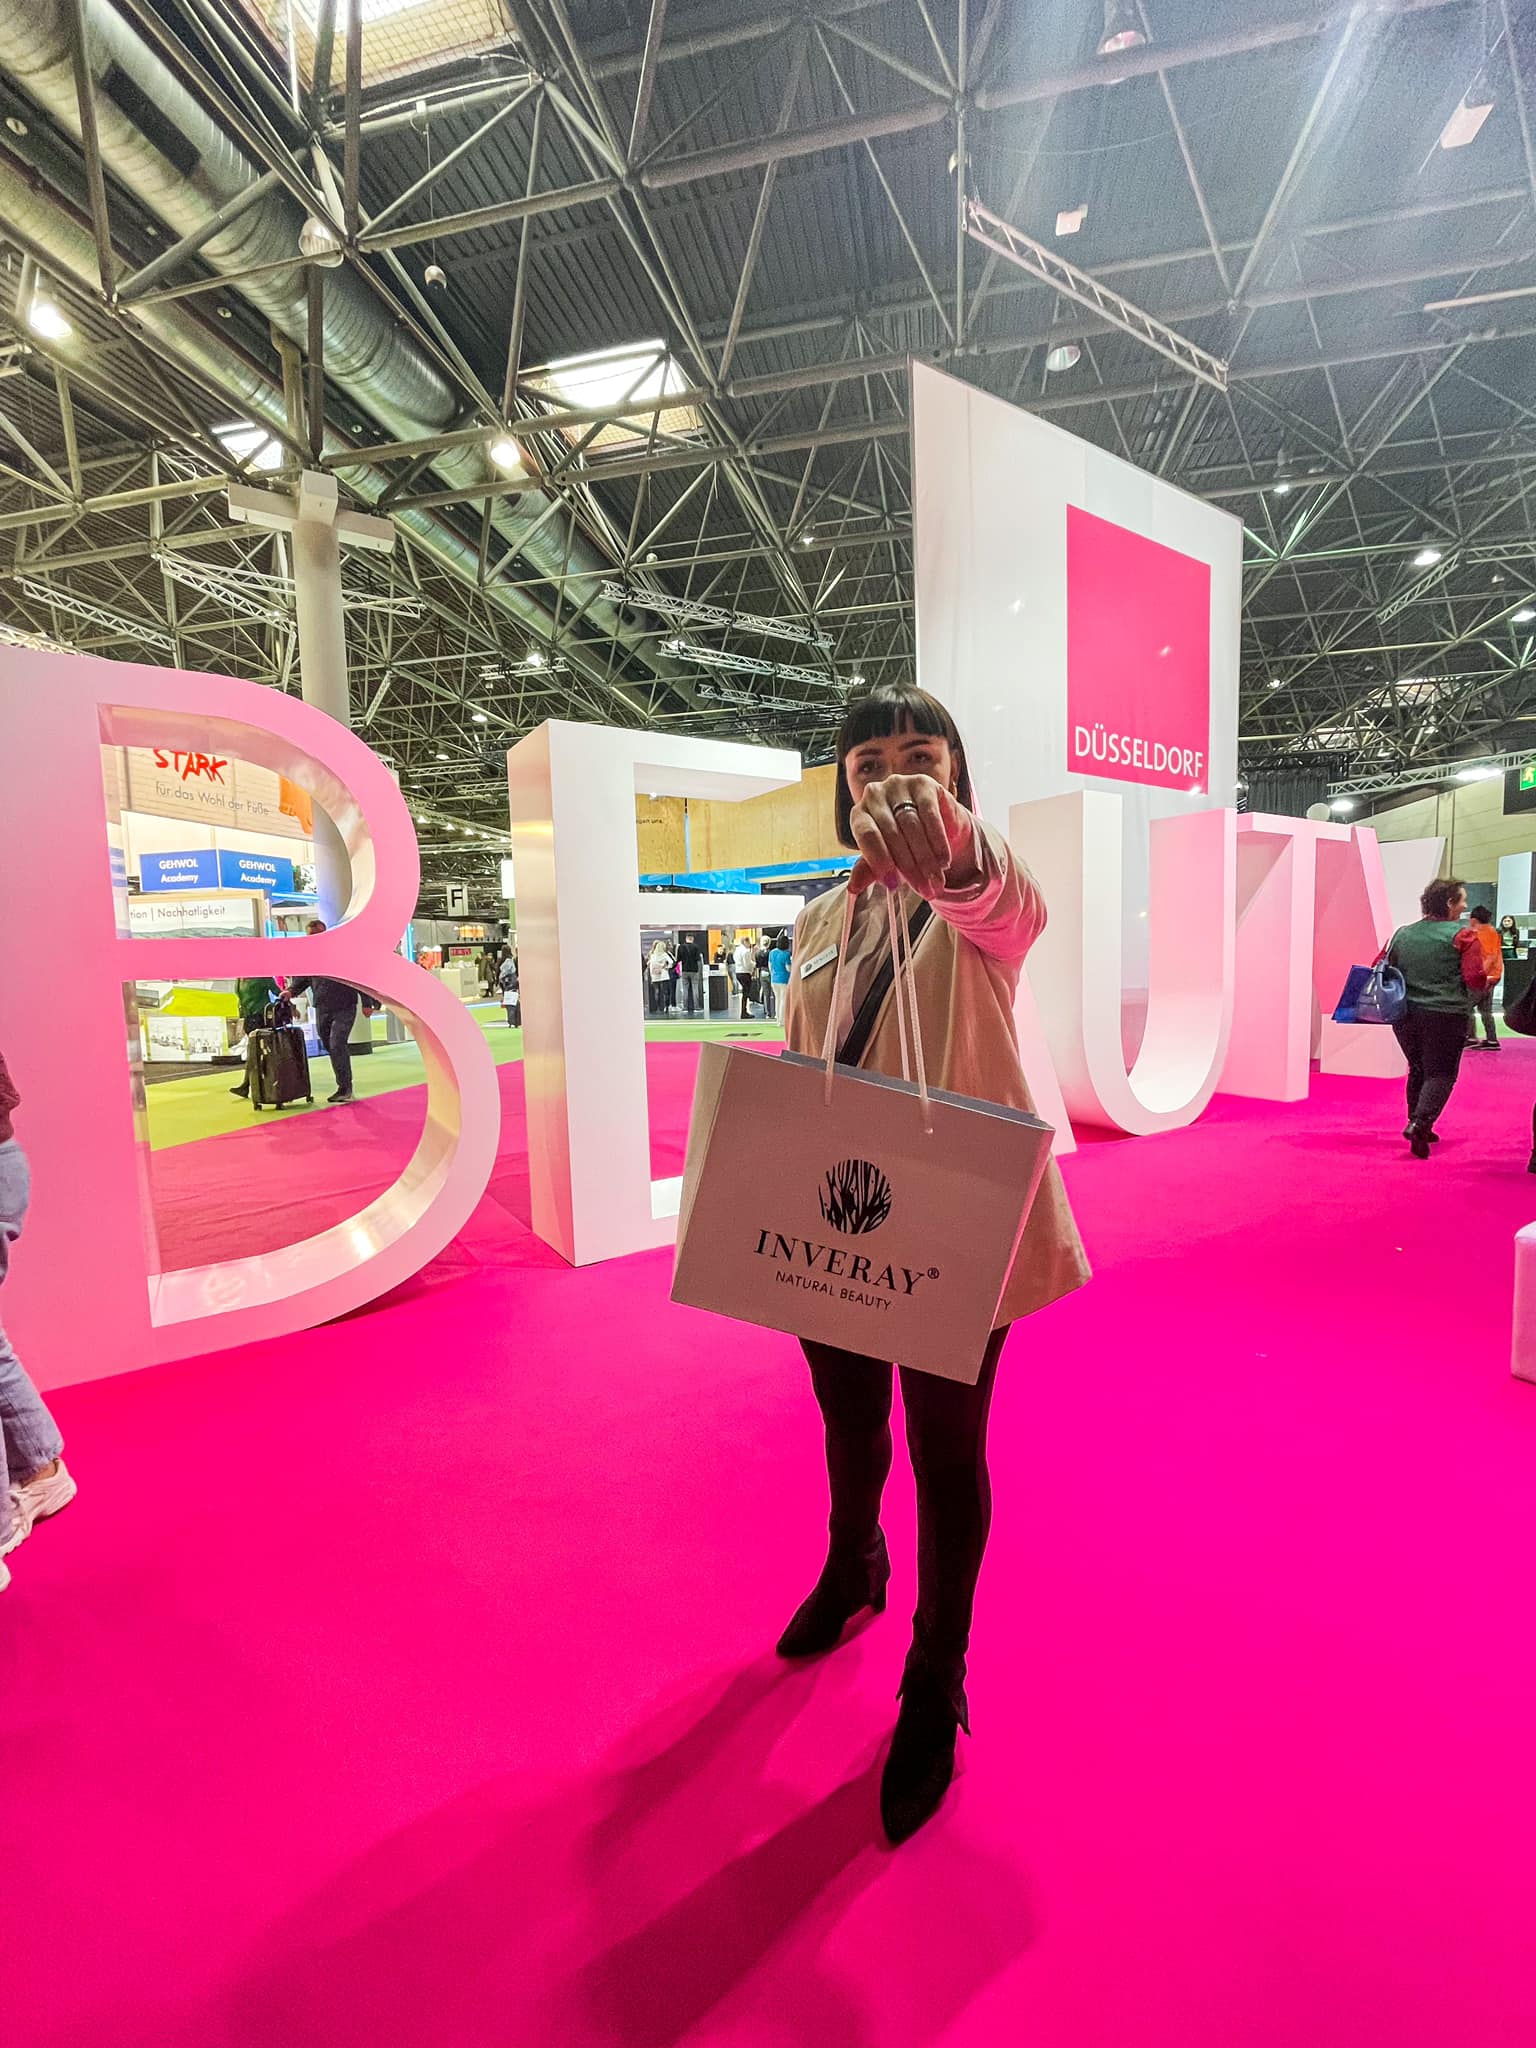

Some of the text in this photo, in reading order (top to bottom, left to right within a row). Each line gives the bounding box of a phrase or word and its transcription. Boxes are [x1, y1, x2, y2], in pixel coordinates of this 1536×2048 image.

[1075, 723, 1204, 778] DÜSSELDORF
[153, 749, 227, 785] STARK
[155, 781, 170, 795] für
[174, 785, 194, 800] das
[198, 792, 225, 806] Wohl
[228, 797, 243, 810] der
[158, 858, 199, 870] GEHWOL
[238, 859, 277, 873] GEHWOL
[160, 872, 199, 884] Academy
[240, 872, 277, 887] Academy
[451, 888, 463, 908] F
[775, 1270, 892, 1311] NATURAL BEAUTY
